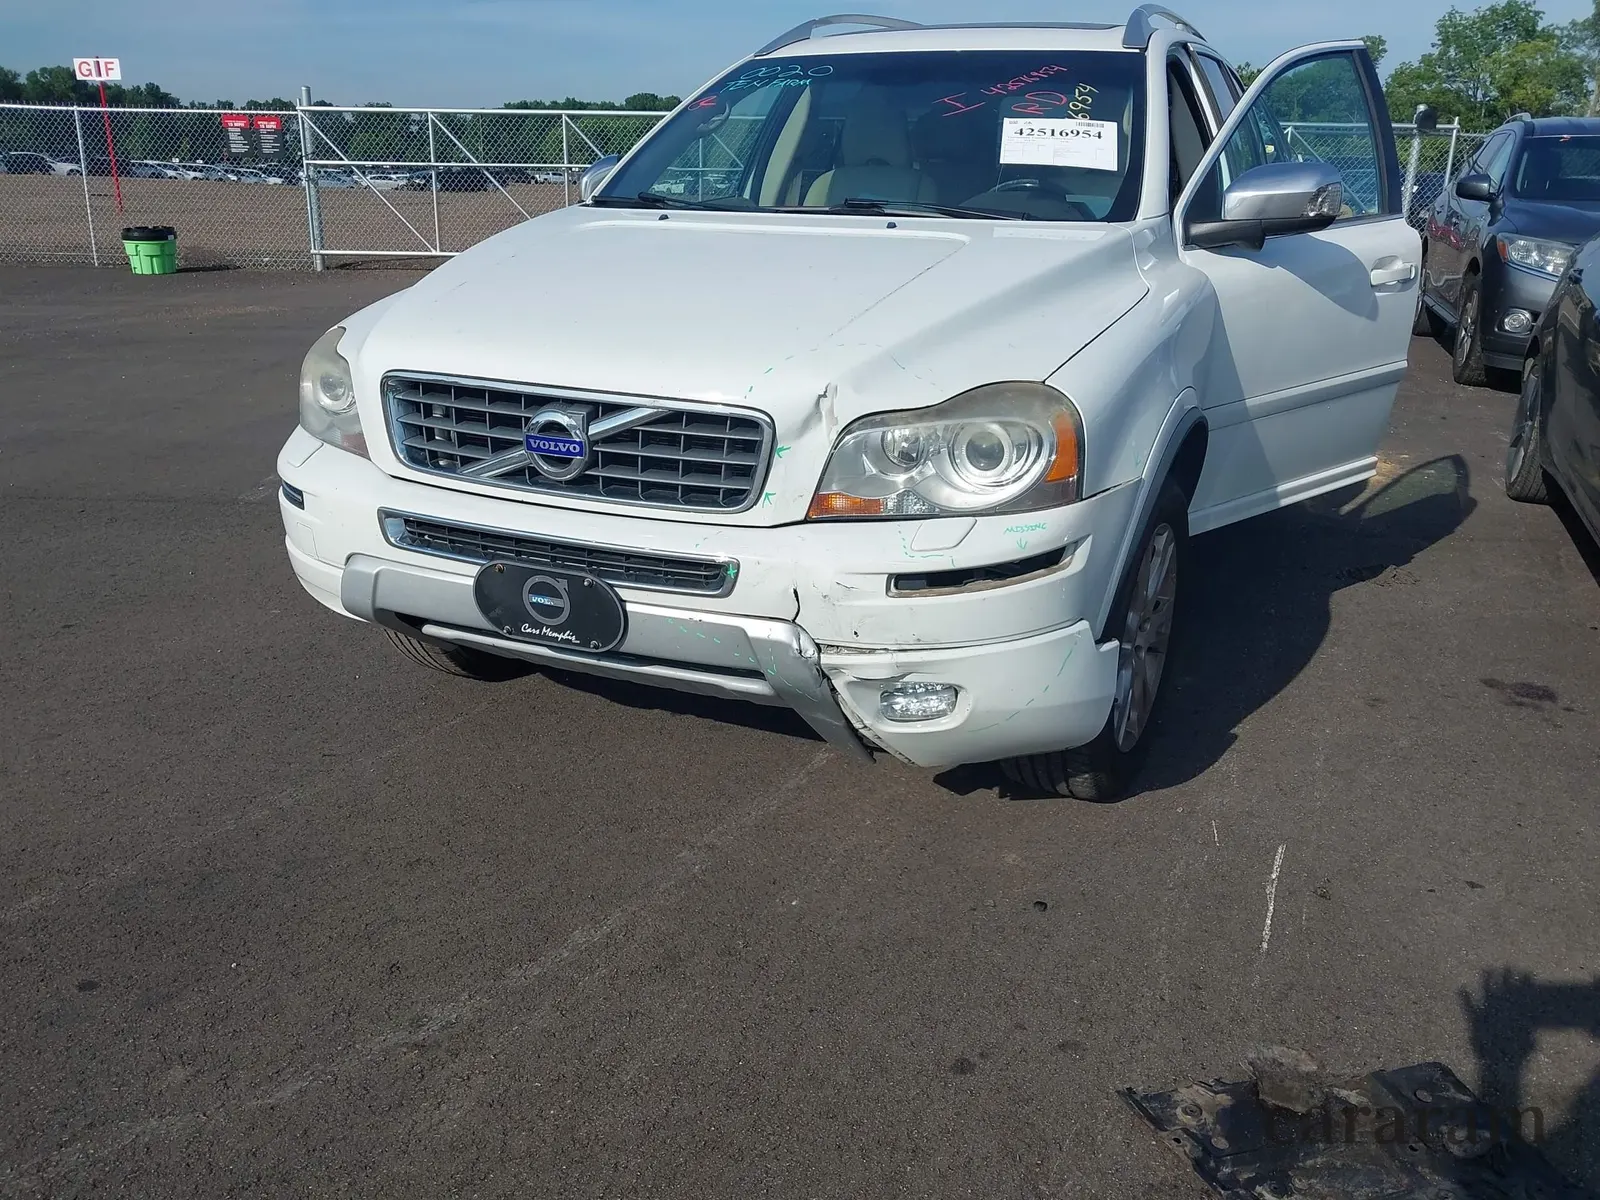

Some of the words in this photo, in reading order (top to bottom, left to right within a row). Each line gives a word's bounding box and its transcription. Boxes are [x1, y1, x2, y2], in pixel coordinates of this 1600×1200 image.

[1013, 127, 1103, 140] 42516954
[527, 437, 581, 455] VOLVO
[521, 623, 540, 634] Cars
[540, 626, 576, 642] Memphis
